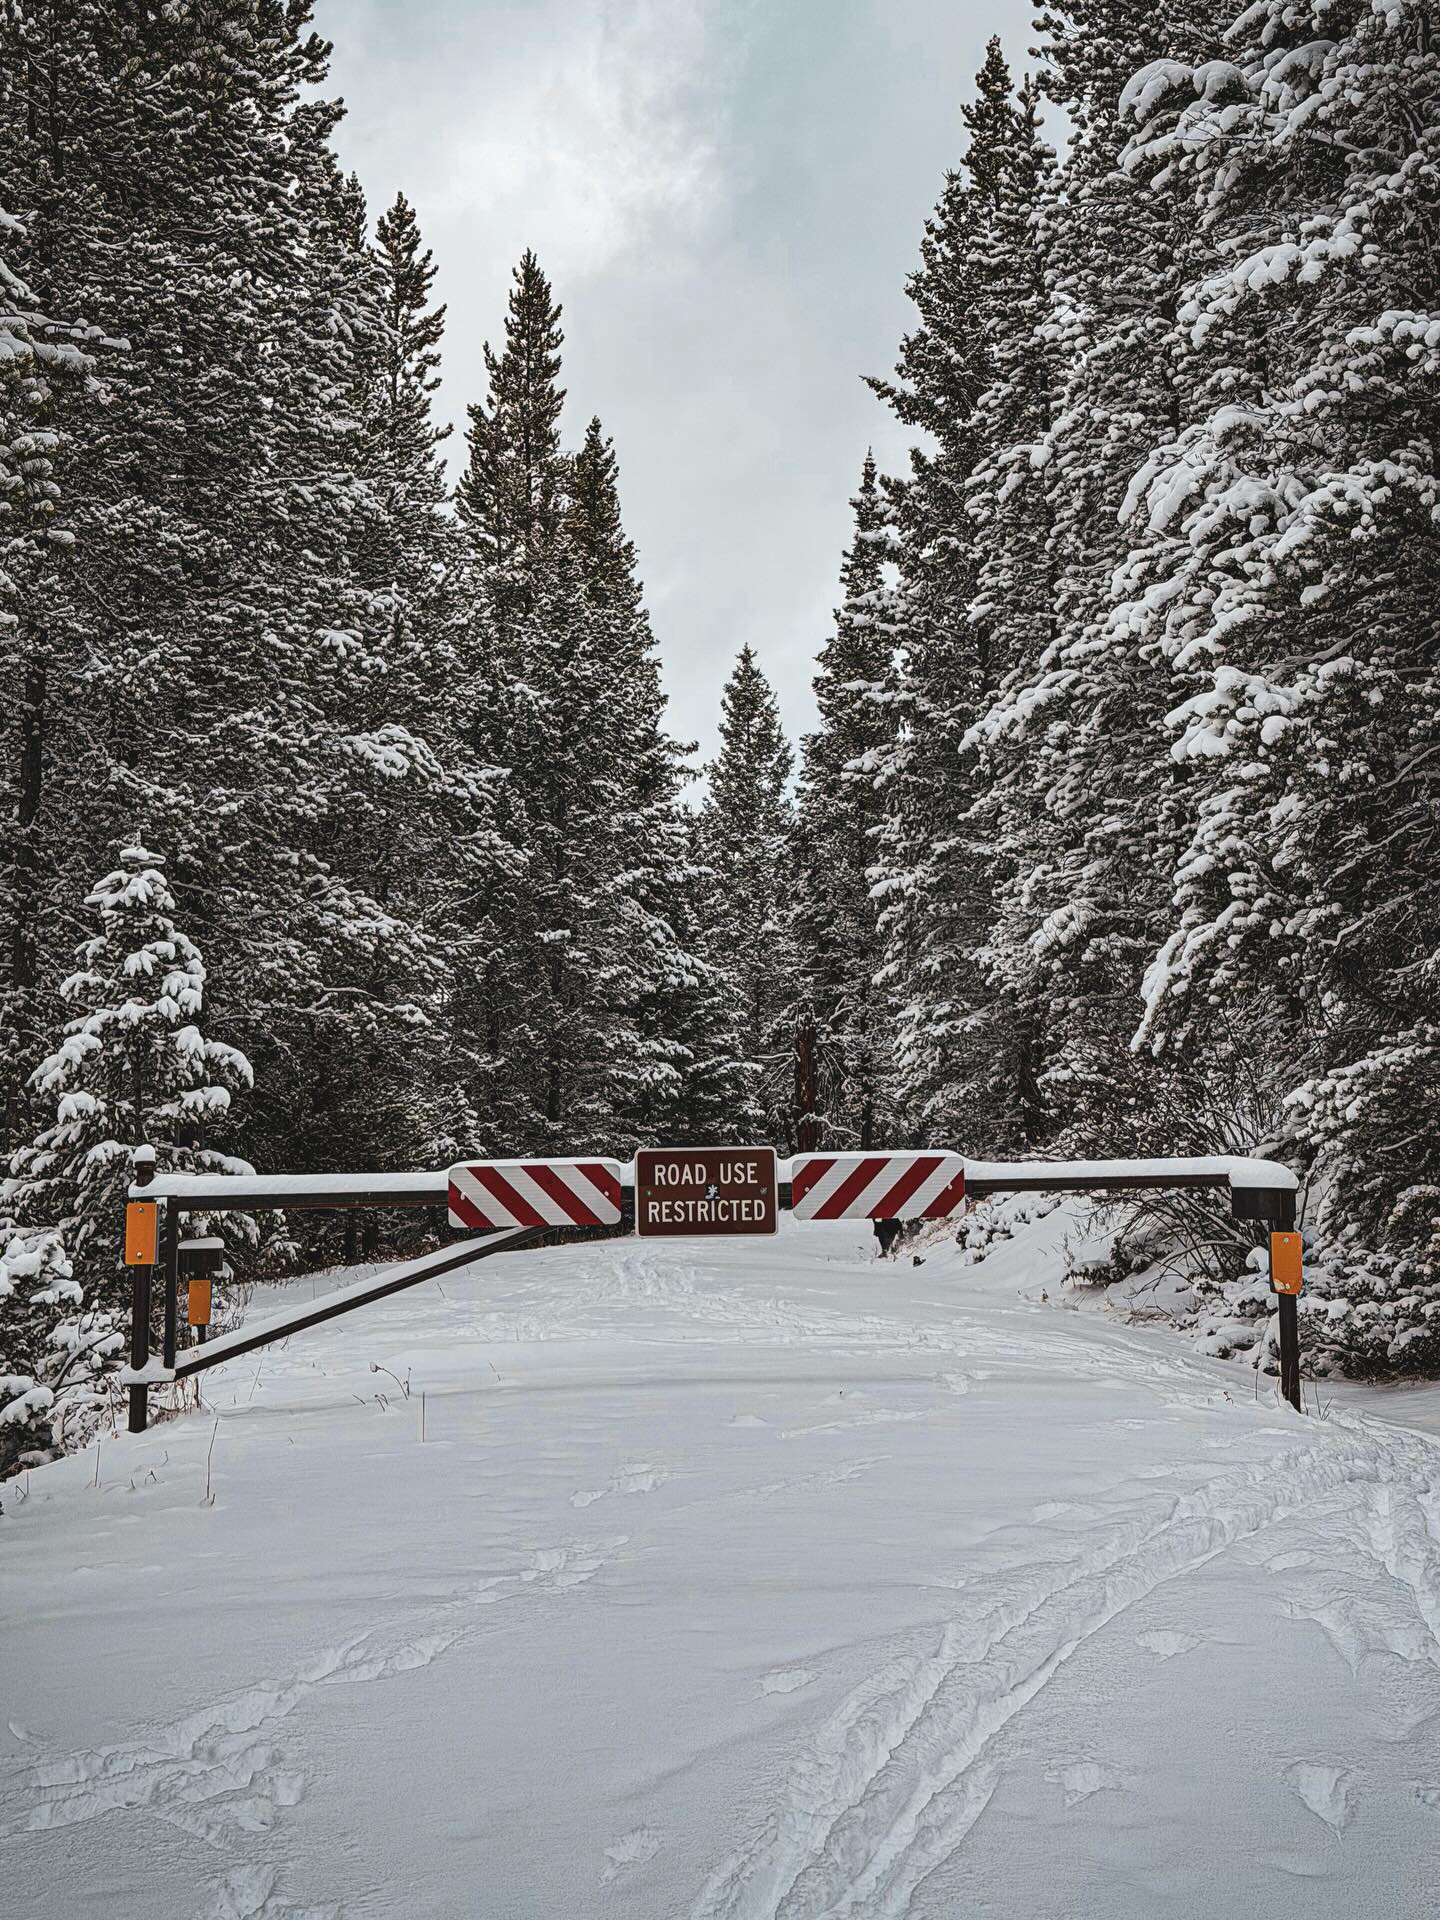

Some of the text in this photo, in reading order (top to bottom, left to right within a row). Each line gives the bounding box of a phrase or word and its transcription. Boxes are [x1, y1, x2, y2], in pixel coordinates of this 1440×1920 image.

[654, 1162, 758, 1186] ROAD USE
[648, 1199, 766, 1223] RESTRICTED
